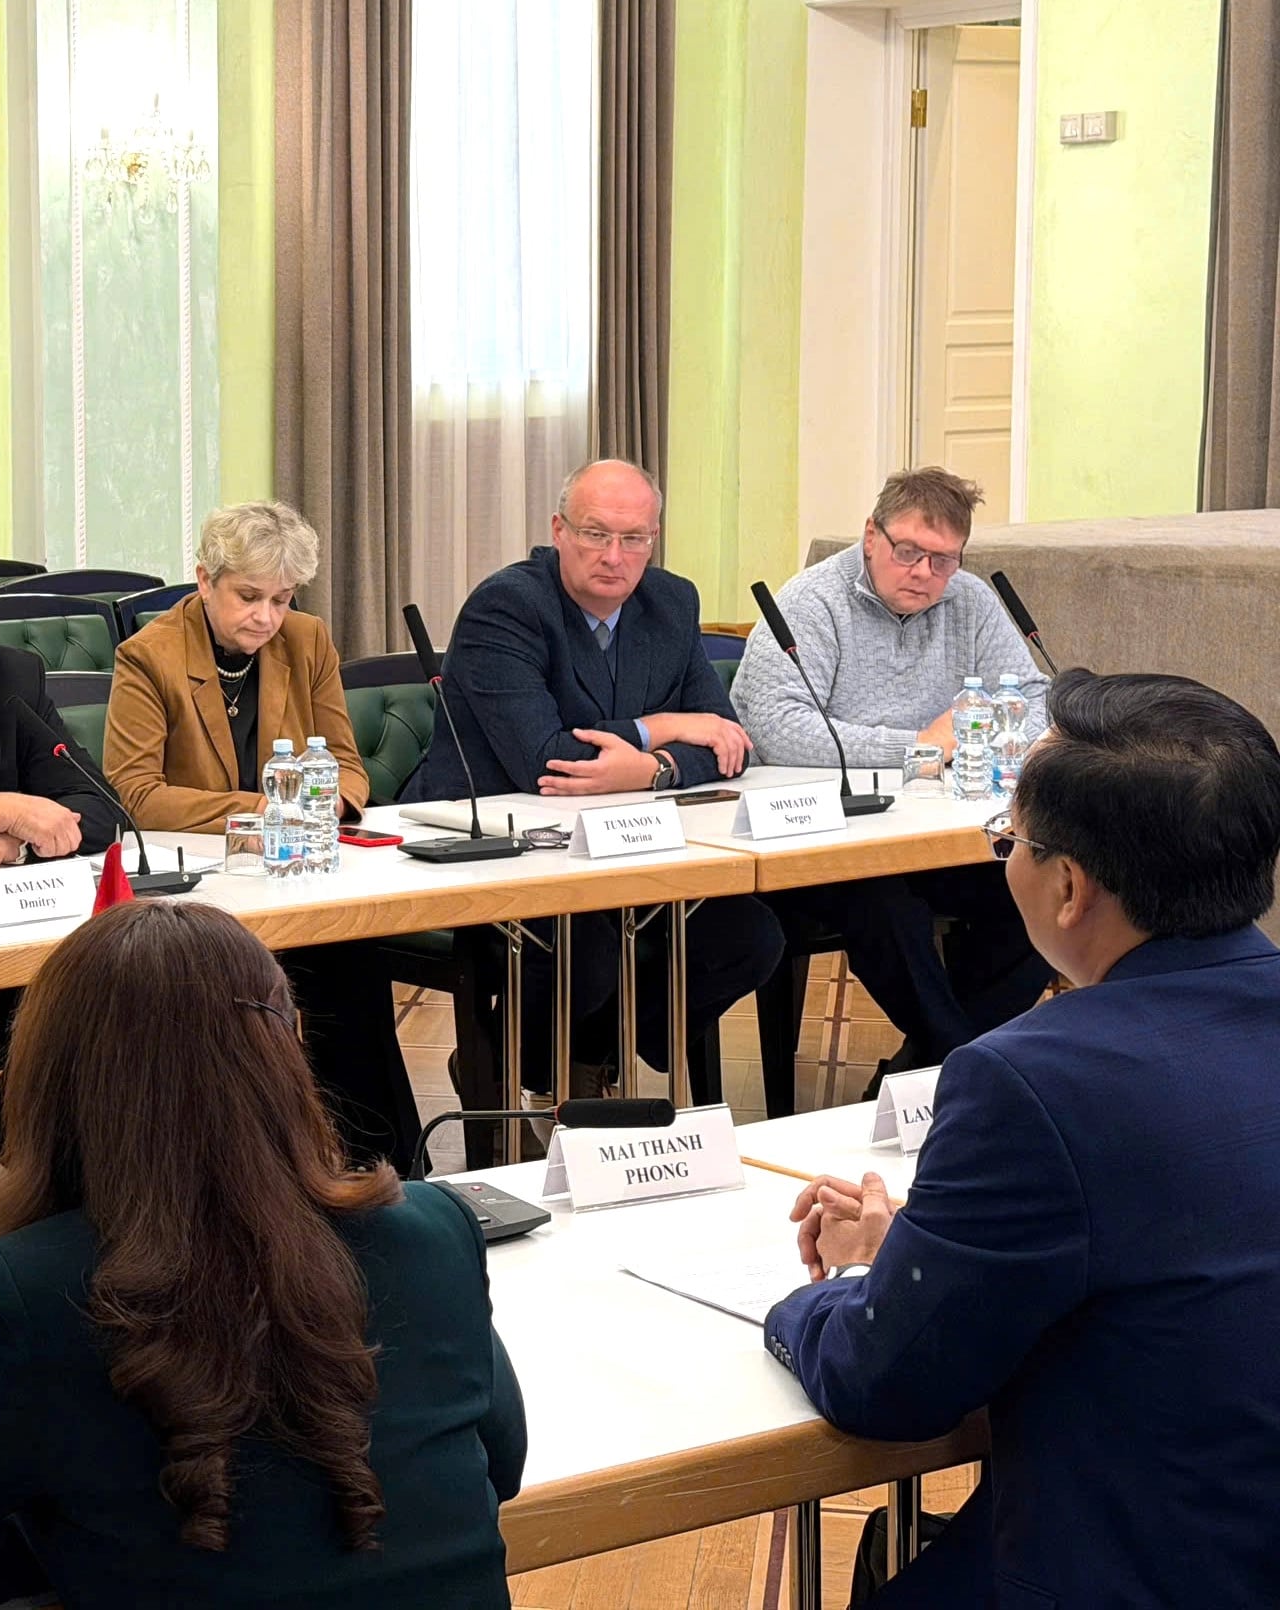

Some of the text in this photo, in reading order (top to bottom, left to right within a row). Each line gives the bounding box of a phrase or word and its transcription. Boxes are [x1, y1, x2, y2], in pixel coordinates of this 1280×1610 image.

[769, 795, 818, 811] SHMATOV
[603, 815, 662, 831] TUMANOVA
[784, 814, 812, 825] Sergey
[621, 832, 653, 844] Marina
[4, 877, 65, 895] KAMANIN
[19, 896, 57, 909] Dmitry
[598, 1134, 703, 1163] MAI THANH
[624, 1161, 689, 1185] PHONG
